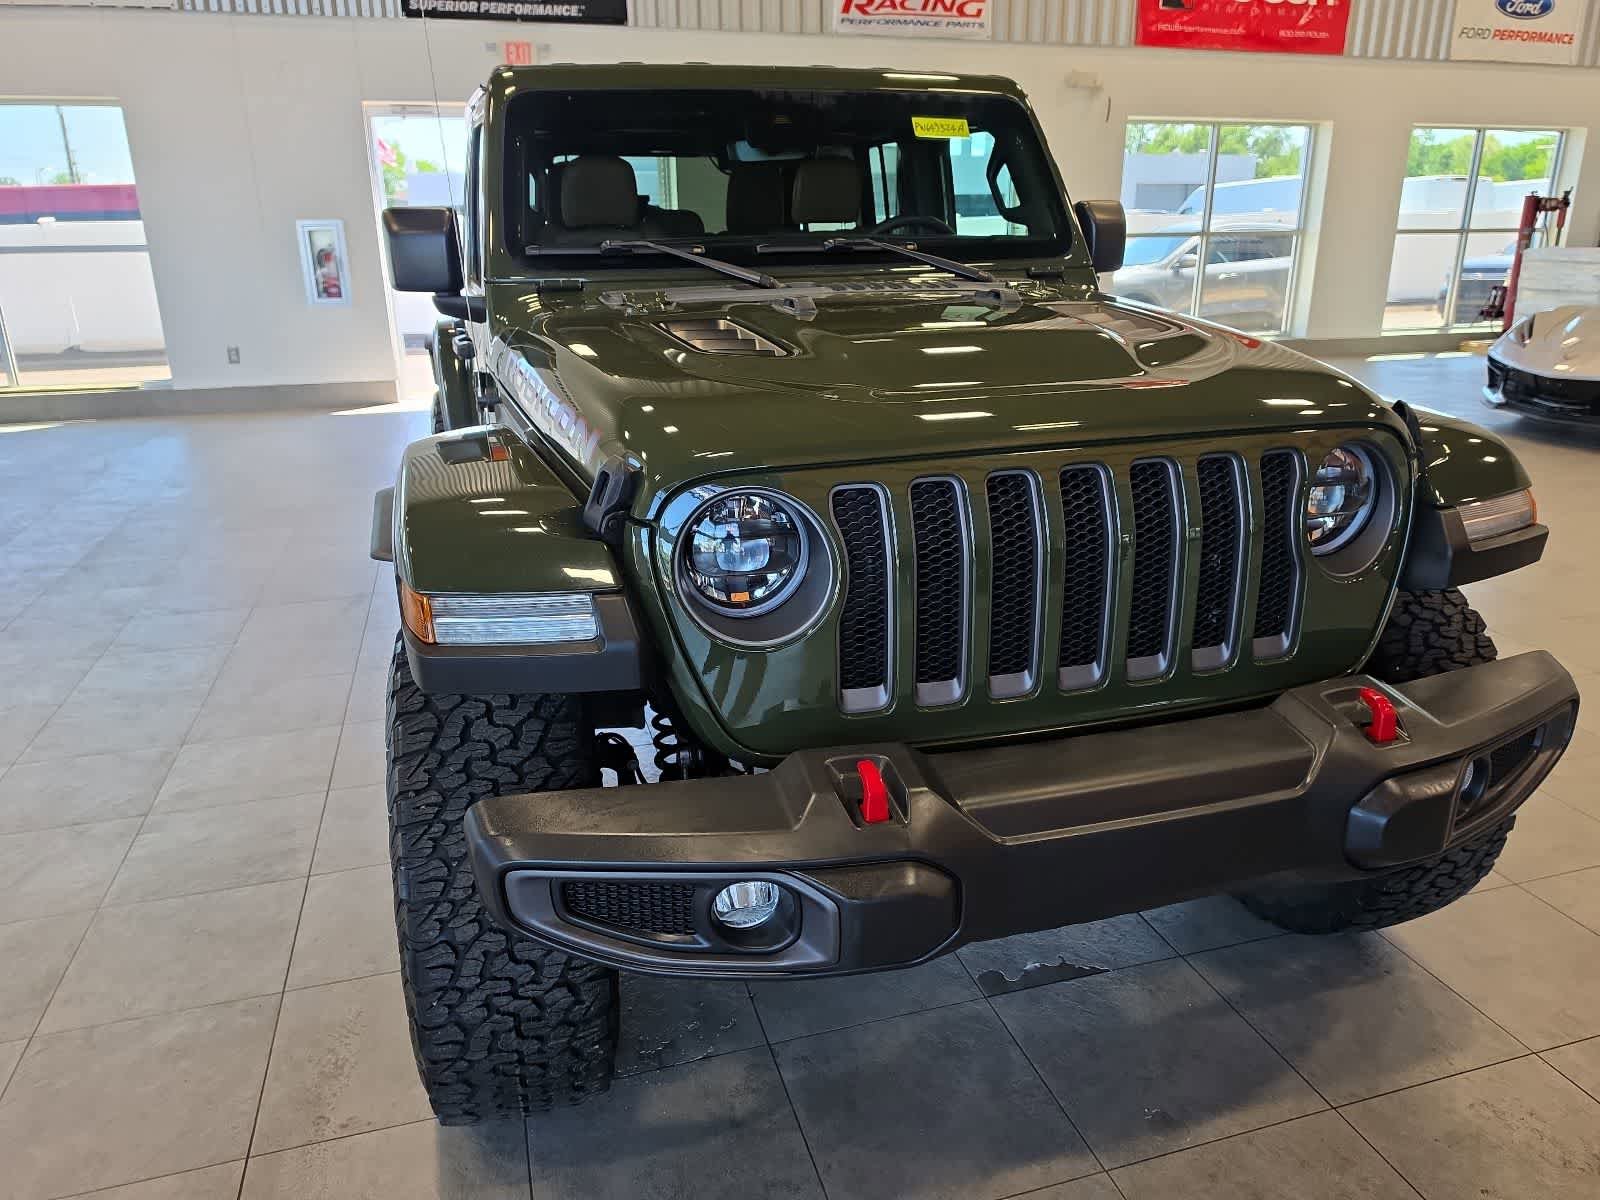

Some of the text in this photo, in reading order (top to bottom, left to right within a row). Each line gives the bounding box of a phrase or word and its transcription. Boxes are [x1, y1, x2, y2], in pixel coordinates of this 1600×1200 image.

[409, 0, 479, 13] SUPERIOR
[841, 0, 986, 18] RACING
[841, 17, 985, 29] PERFORMANCE PARTS
[1459, 26, 1575, 45] FORD PERFORMANCE
[505, 42, 532, 65] EXIT
